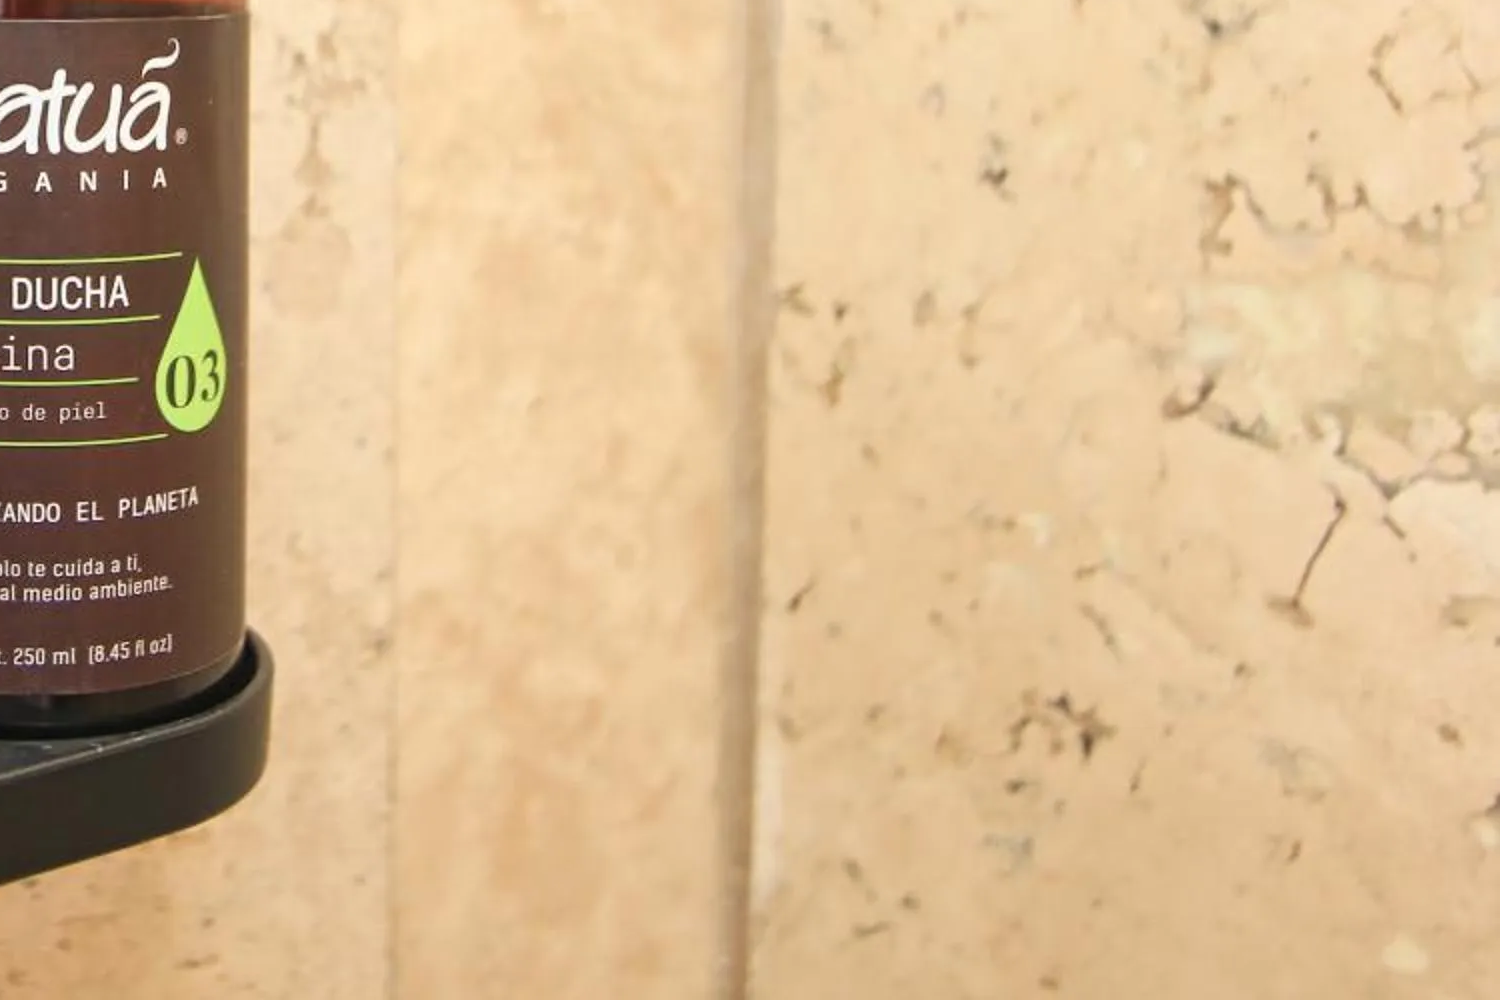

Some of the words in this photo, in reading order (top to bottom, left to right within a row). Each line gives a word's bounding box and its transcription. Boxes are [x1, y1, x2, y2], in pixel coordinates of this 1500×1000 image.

[11, 275, 130, 311] DUCHA
[165, 349, 220, 409] 03
[22, 404, 46, 421] de
[59, 402, 107, 424] piel
[77, 502, 104, 521] EL
[118, 486, 199, 519] PLANETA
[27, 563, 46, 578] te
[52, 557, 104, 577] cuida
[111, 559, 120, 573] a
[0, 584, 16, 601] al
[23, 583, 83, 602] medio
[89, 575, 174, 600] ambiente.
[13, 647, 45, 665] 250
[52, 645, 76, 665] ml
